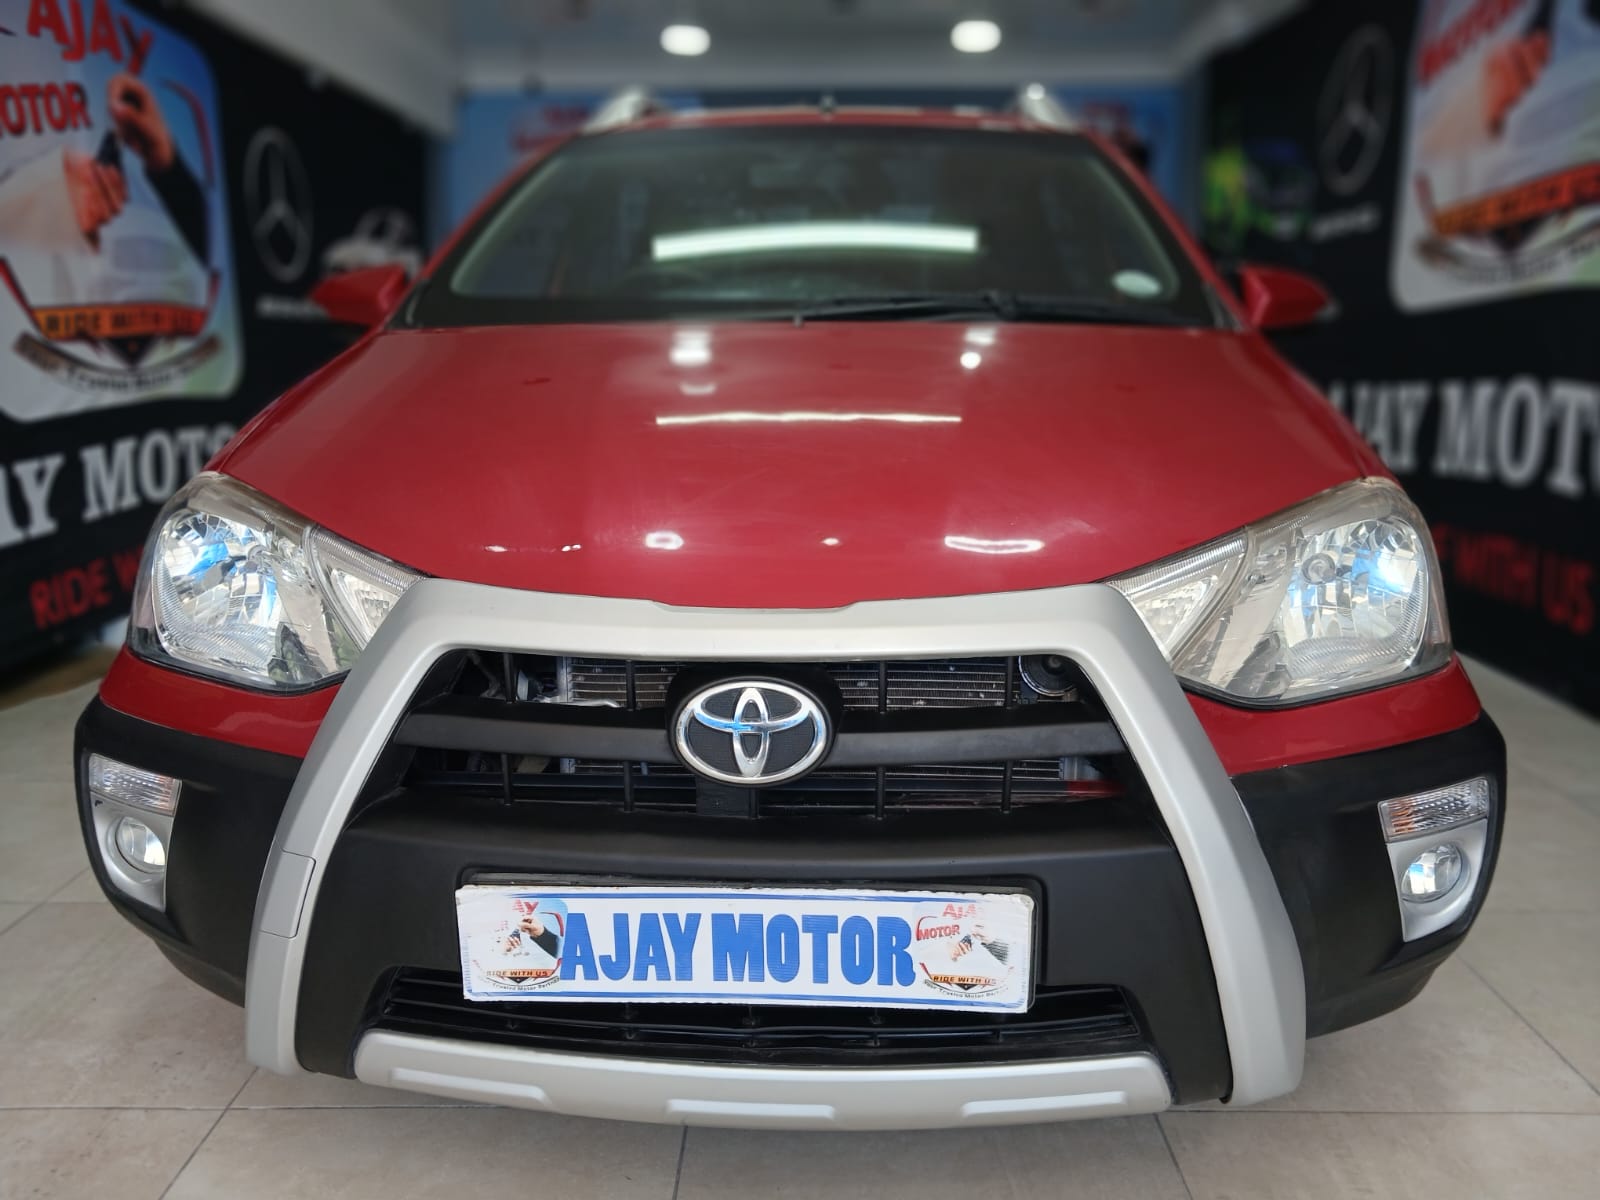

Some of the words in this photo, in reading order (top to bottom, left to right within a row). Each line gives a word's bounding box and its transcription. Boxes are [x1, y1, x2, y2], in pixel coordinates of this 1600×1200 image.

[27, 0, 154, 76] AJAY
[0, 82, 92, 137] OTOR
[561, 912, 702, 981] AJAY
[711, 913, 916, 987] MOTOR
[918, 924, 961, 941] MOTOR
[933, 975, 955, 983] RIDE
